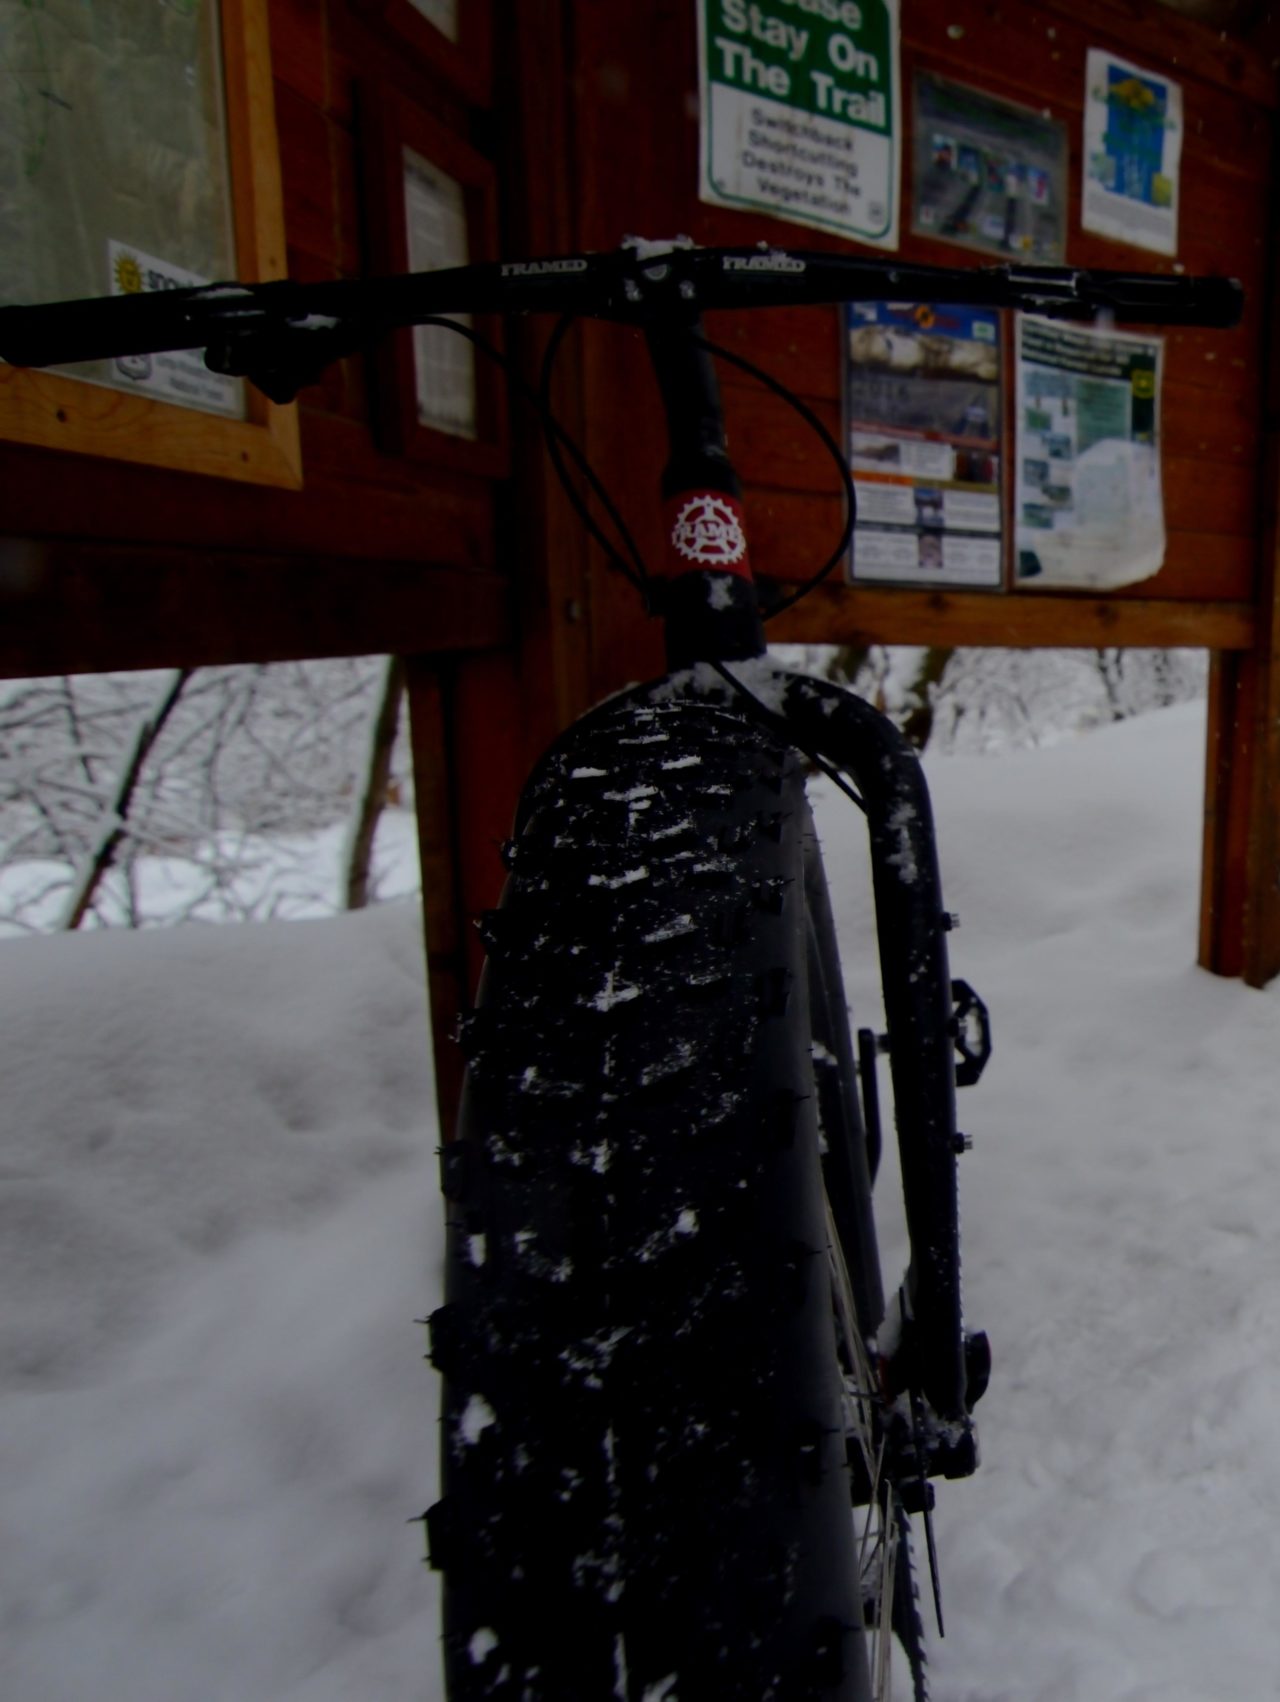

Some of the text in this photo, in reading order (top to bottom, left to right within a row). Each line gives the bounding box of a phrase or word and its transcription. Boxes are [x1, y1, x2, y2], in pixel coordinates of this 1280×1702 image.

[722, 0, 879, 82] Stay On
[713, 35, 791, 97] The
[809, 69, 887, 129] Trail
[752, 108, 854, 150] Switchback
[742, 151, 861, 197] Destroys The
[749, 130, 859, 178] Shortcutting
[758, 177, 849, 213] Vegetation
[501, 258, 588, 277] FRAMED
